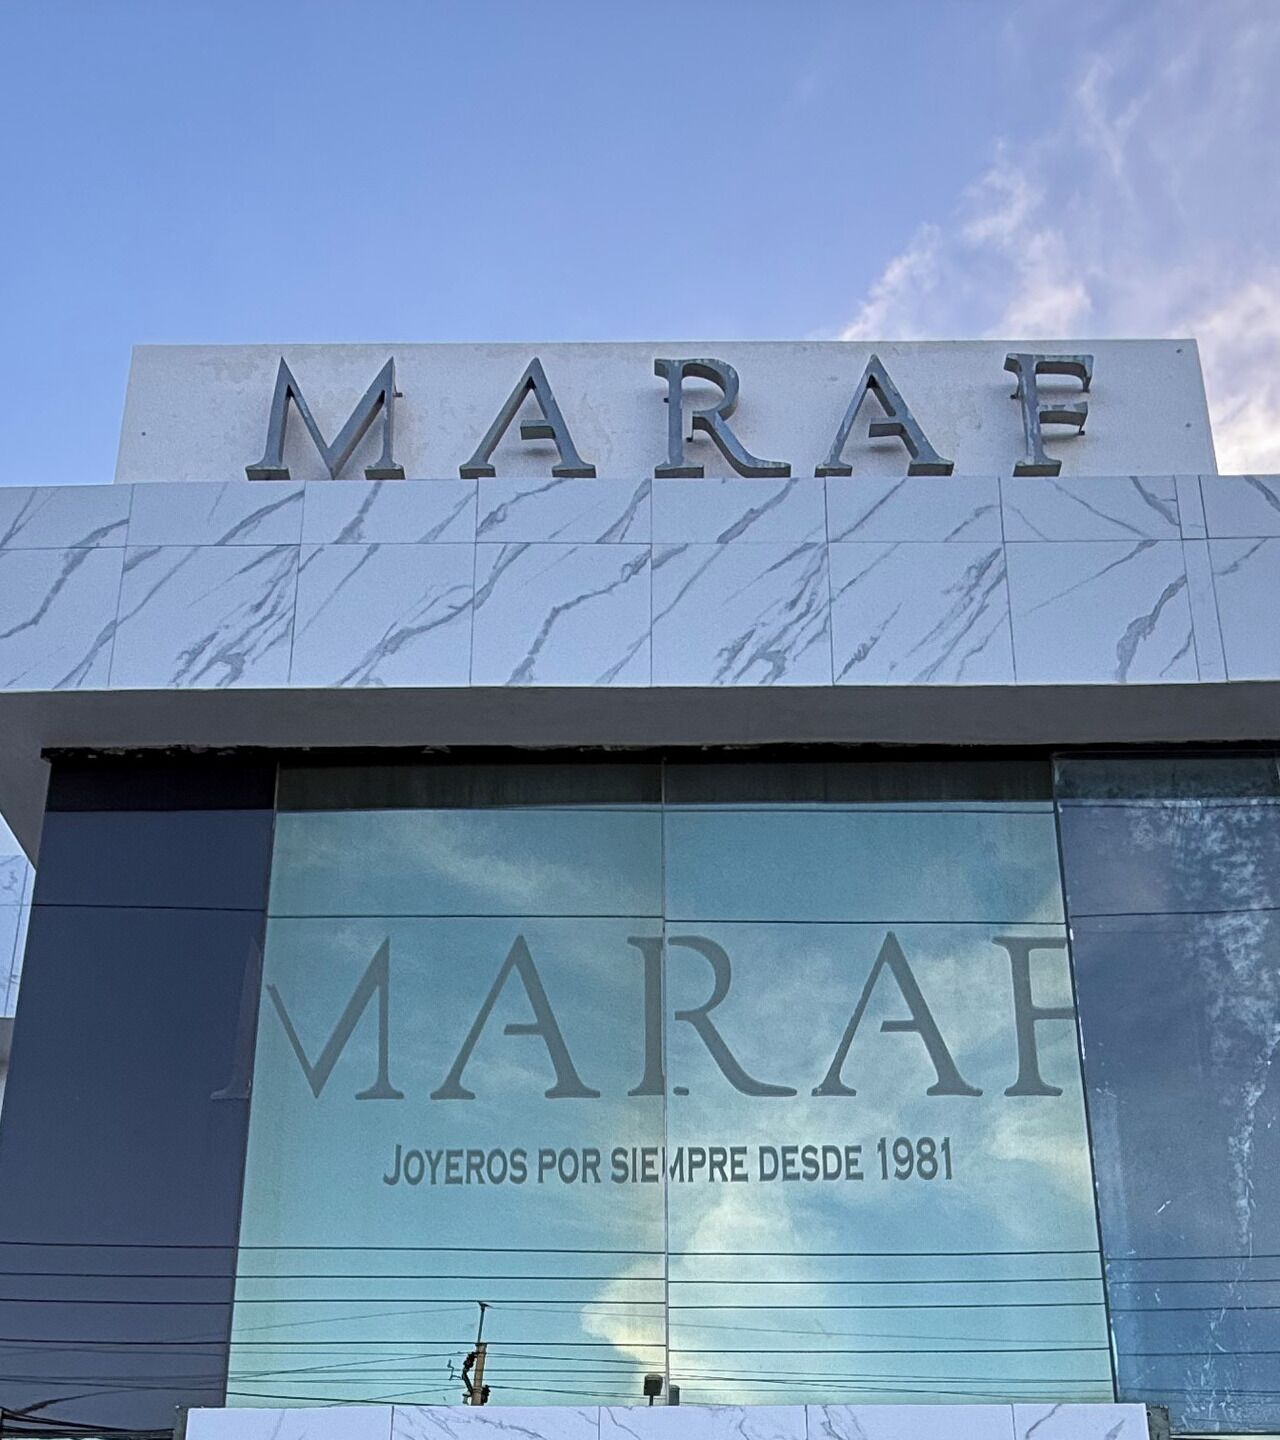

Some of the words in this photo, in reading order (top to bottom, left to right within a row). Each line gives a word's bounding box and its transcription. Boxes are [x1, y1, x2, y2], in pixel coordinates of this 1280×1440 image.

[246, 352, 1094, 480] MARAF
[383, 1143, 528, 1186] JOYEROS
[537, 1147, 601, 1184] POR
[611, 1145, 748, 1183] SIEMPRE
[759, 1144, 864, 1182] DESDE
[877, 1136, 953, 1181] 1981
